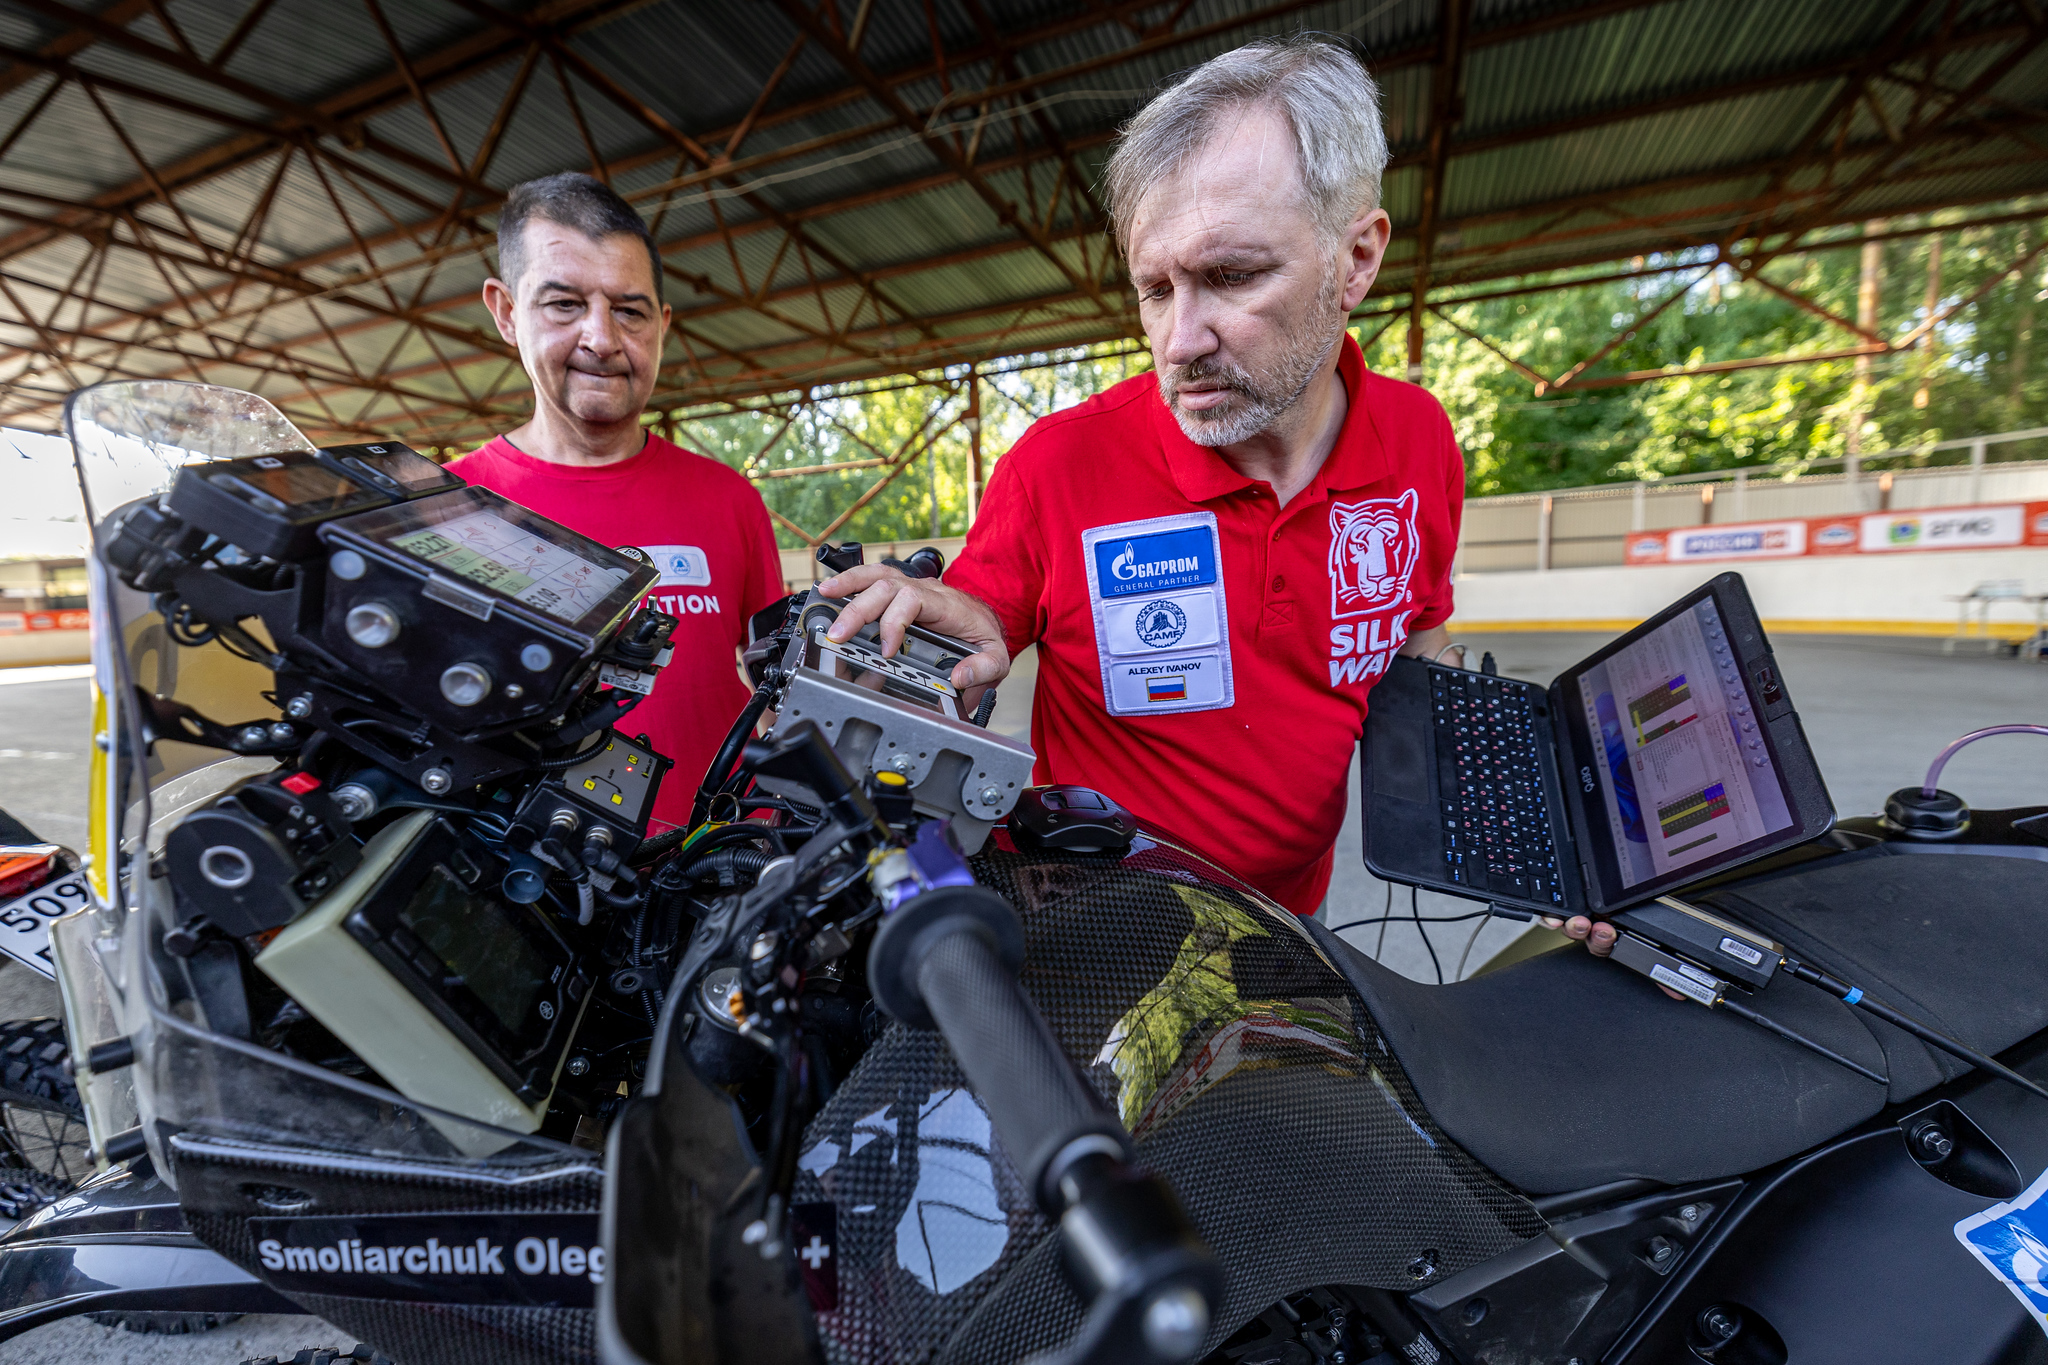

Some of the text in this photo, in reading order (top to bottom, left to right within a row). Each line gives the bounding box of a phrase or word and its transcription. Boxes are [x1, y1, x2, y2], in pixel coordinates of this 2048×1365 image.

[1137, 556, 1199, 579] GAZPROM
[1114, 574, 1200, 593] GENERAL PARTNER
[1144, 630, 1182, 642] CAMF
[1330, 610, 1412, 657] SILK
[1128, 662, 1202, 676] ALEXEY IVANOV
[0, 872, 92, 933] 509
[258, 1237, 506, 1276] Smoliarchuk
[514, 1236, 606, 1285] Oleg
